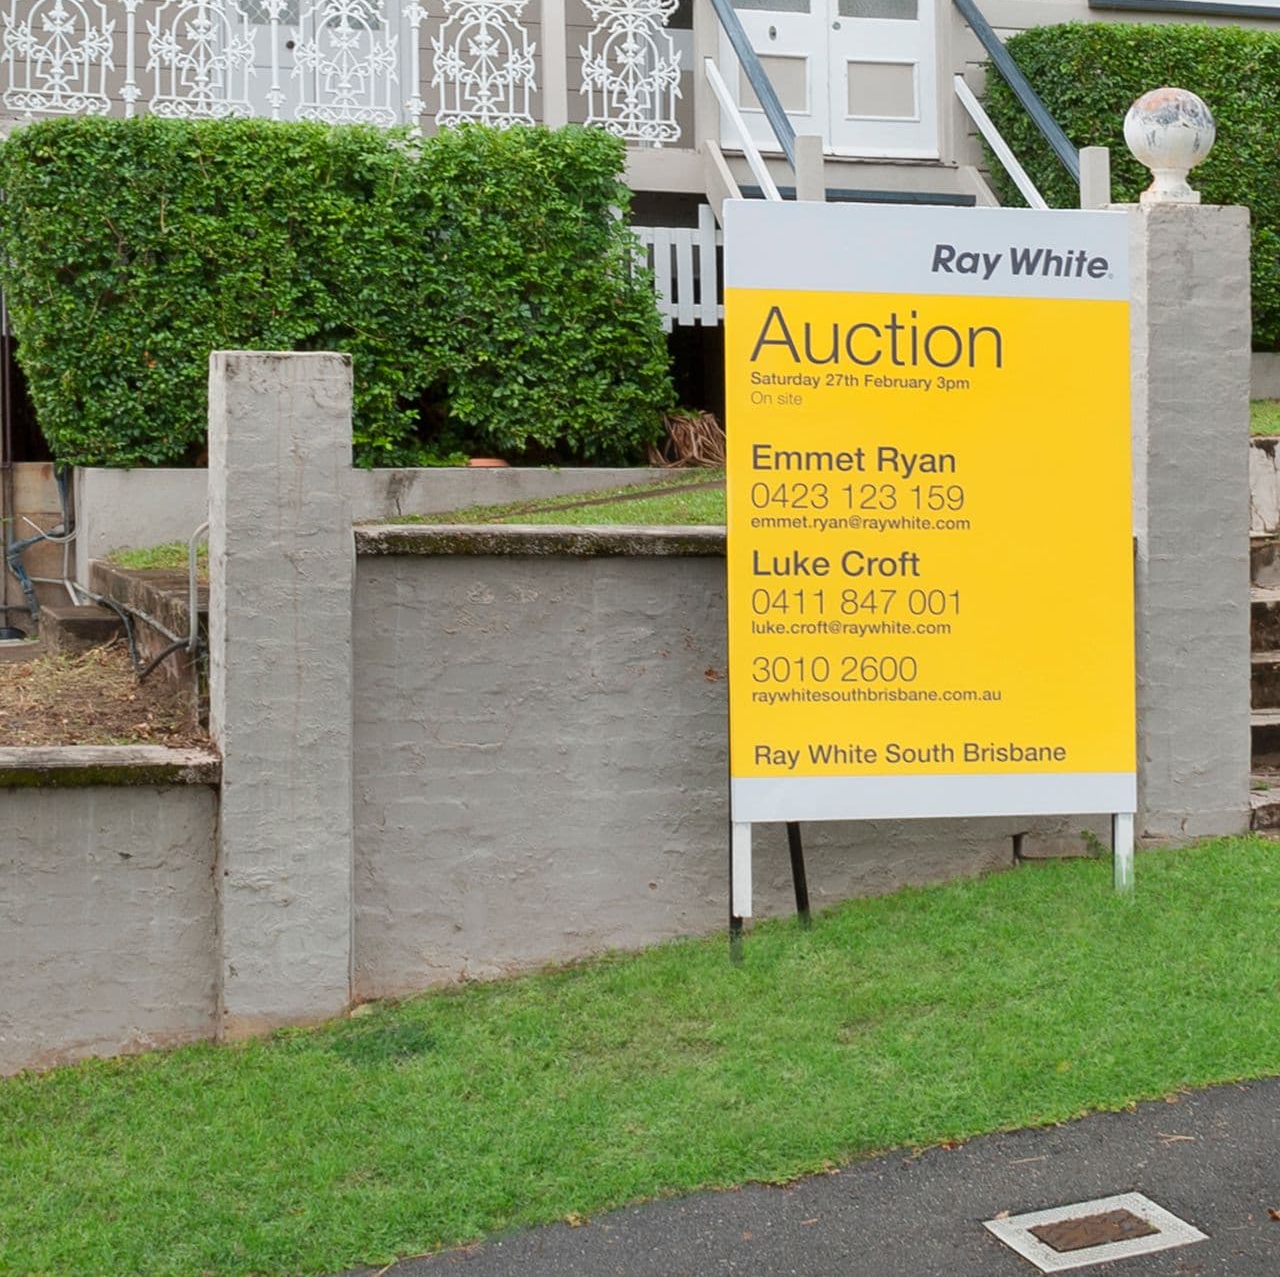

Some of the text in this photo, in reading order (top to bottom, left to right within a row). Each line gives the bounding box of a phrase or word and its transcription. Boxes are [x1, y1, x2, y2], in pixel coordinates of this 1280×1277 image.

[931, 244, 1109, 281] Ray White
[749, 305, 1002, 369] Auction
[750, 370, 970, 392] Saturday 27th February 3pm
[750, 390, 803, 406] On site
[752, 443, 956, 480] Emmet Ryan
[751, 481, 965, 512] 0423 123 159
[750, 514, 971, 533] emmet.ryan@raywhite.com
[752, 549, 921, 577] Luke Croft
[751, 588, 960, 616] 0411 847 001
[751, 620, 951, 638] luke.croft@raywhite.com
[751, 655, 918, 684] 3010 2600
[751, 687, 1002, 705] raywhitesouthbrisbane.com.au
[754, 742, 1067, 771] Ray White South Brisbane
